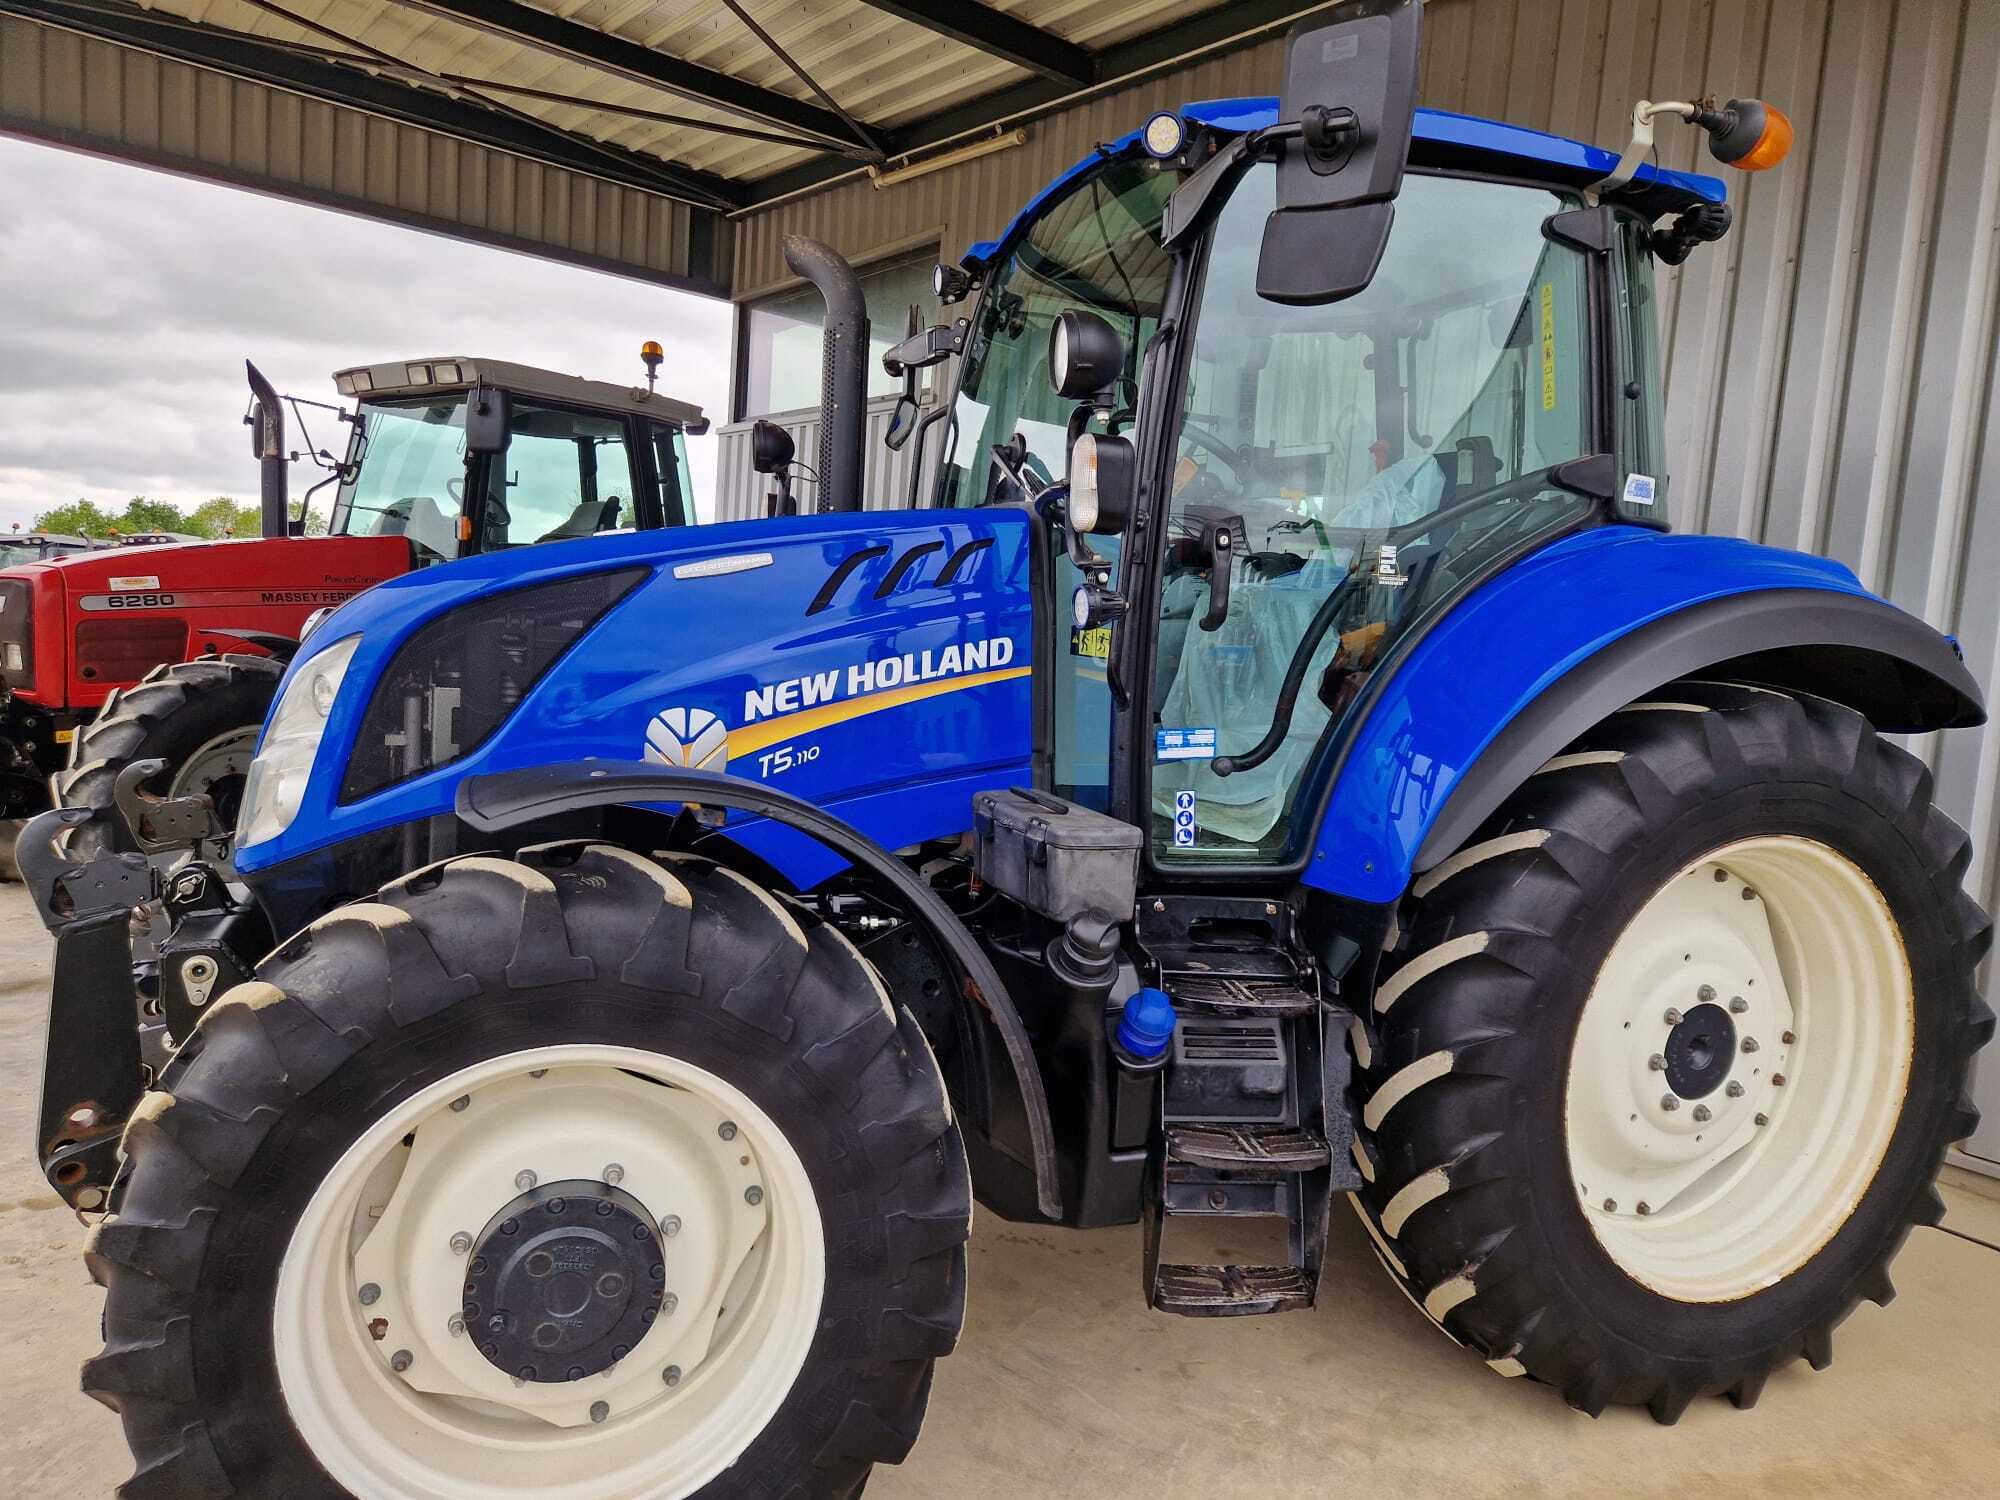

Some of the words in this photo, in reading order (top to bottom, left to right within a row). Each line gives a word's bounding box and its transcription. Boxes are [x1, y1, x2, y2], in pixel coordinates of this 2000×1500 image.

[108, 594, 175, 608] 6280
[261, 592, 319, 603] MASSEY
[322, 592, 357, 602] FERG
[744, 669, 840, 722] NEW
[847, 636, 1014, 696] HOLLAND
[758, 745, 820, 778] T5.110
